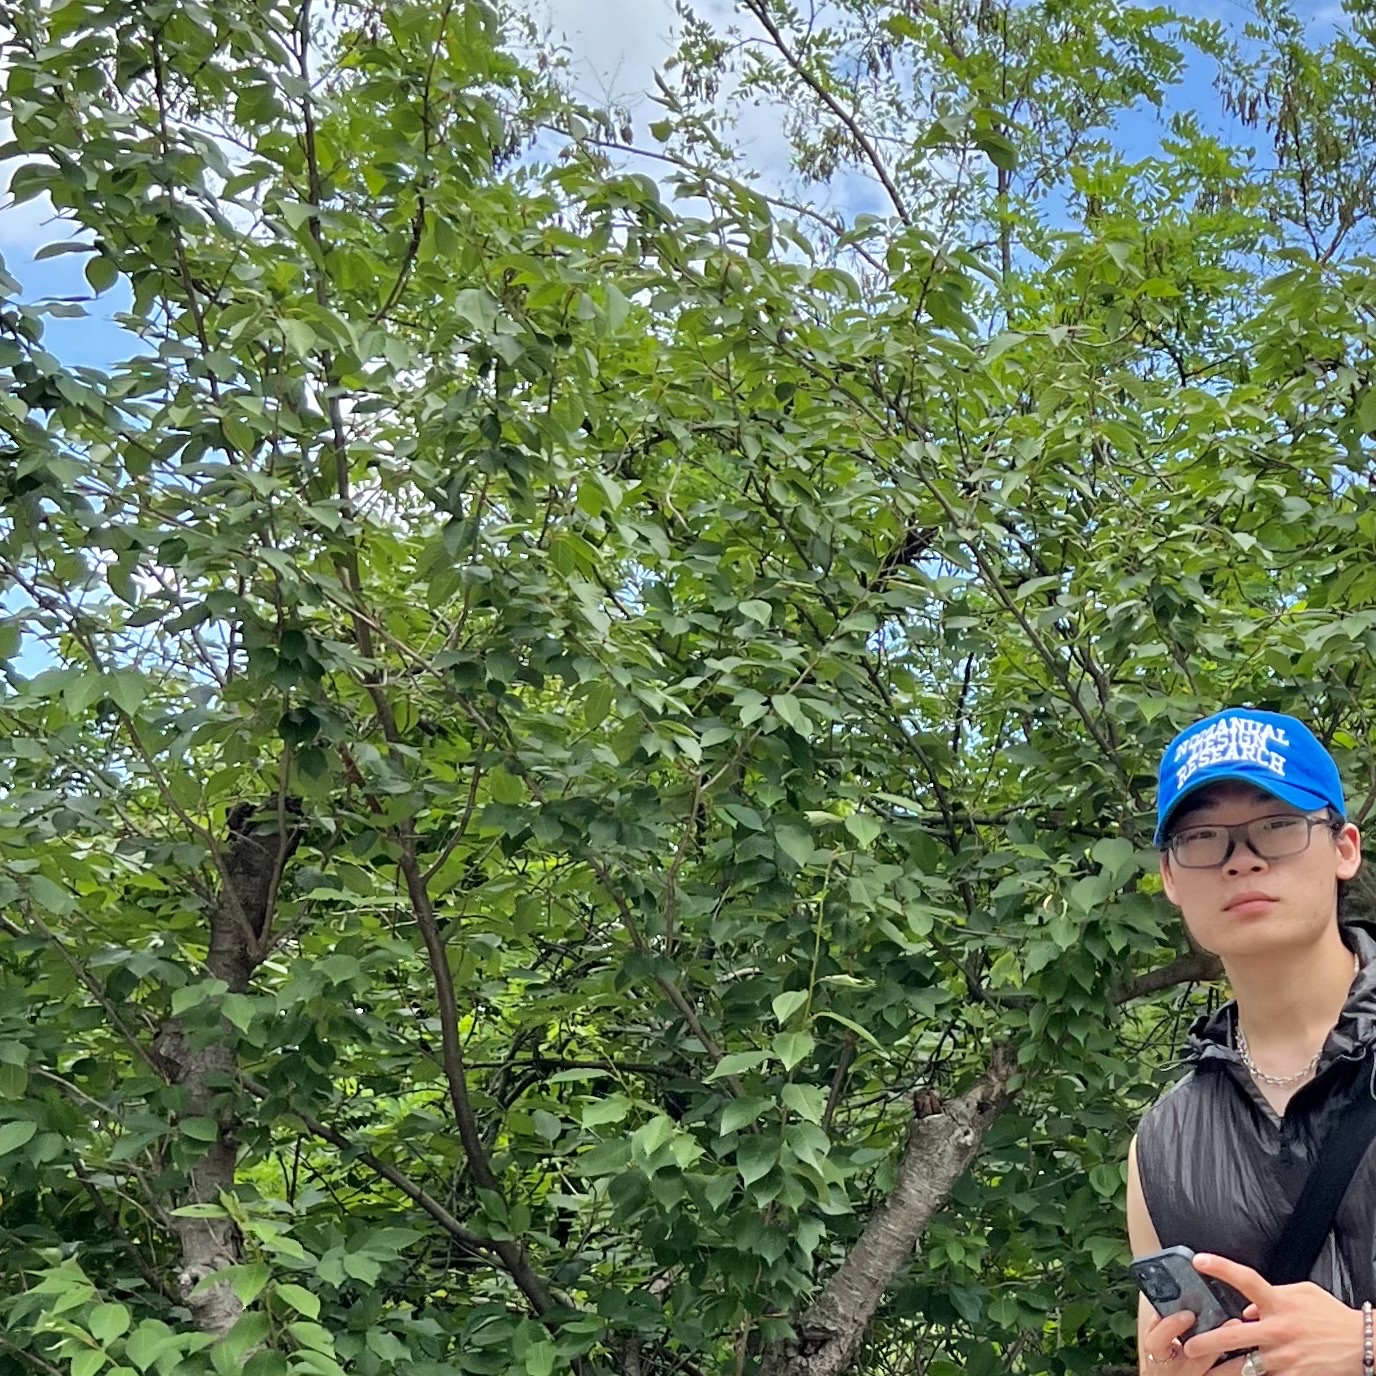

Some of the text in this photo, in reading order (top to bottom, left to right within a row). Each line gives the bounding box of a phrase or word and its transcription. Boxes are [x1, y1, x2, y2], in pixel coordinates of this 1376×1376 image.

[1174, 717, 1290, 762] NOMANUAL
[1191, 729, 1268, 757] DESIGN
[1176, 745, 1287, 789] RESEARCH
